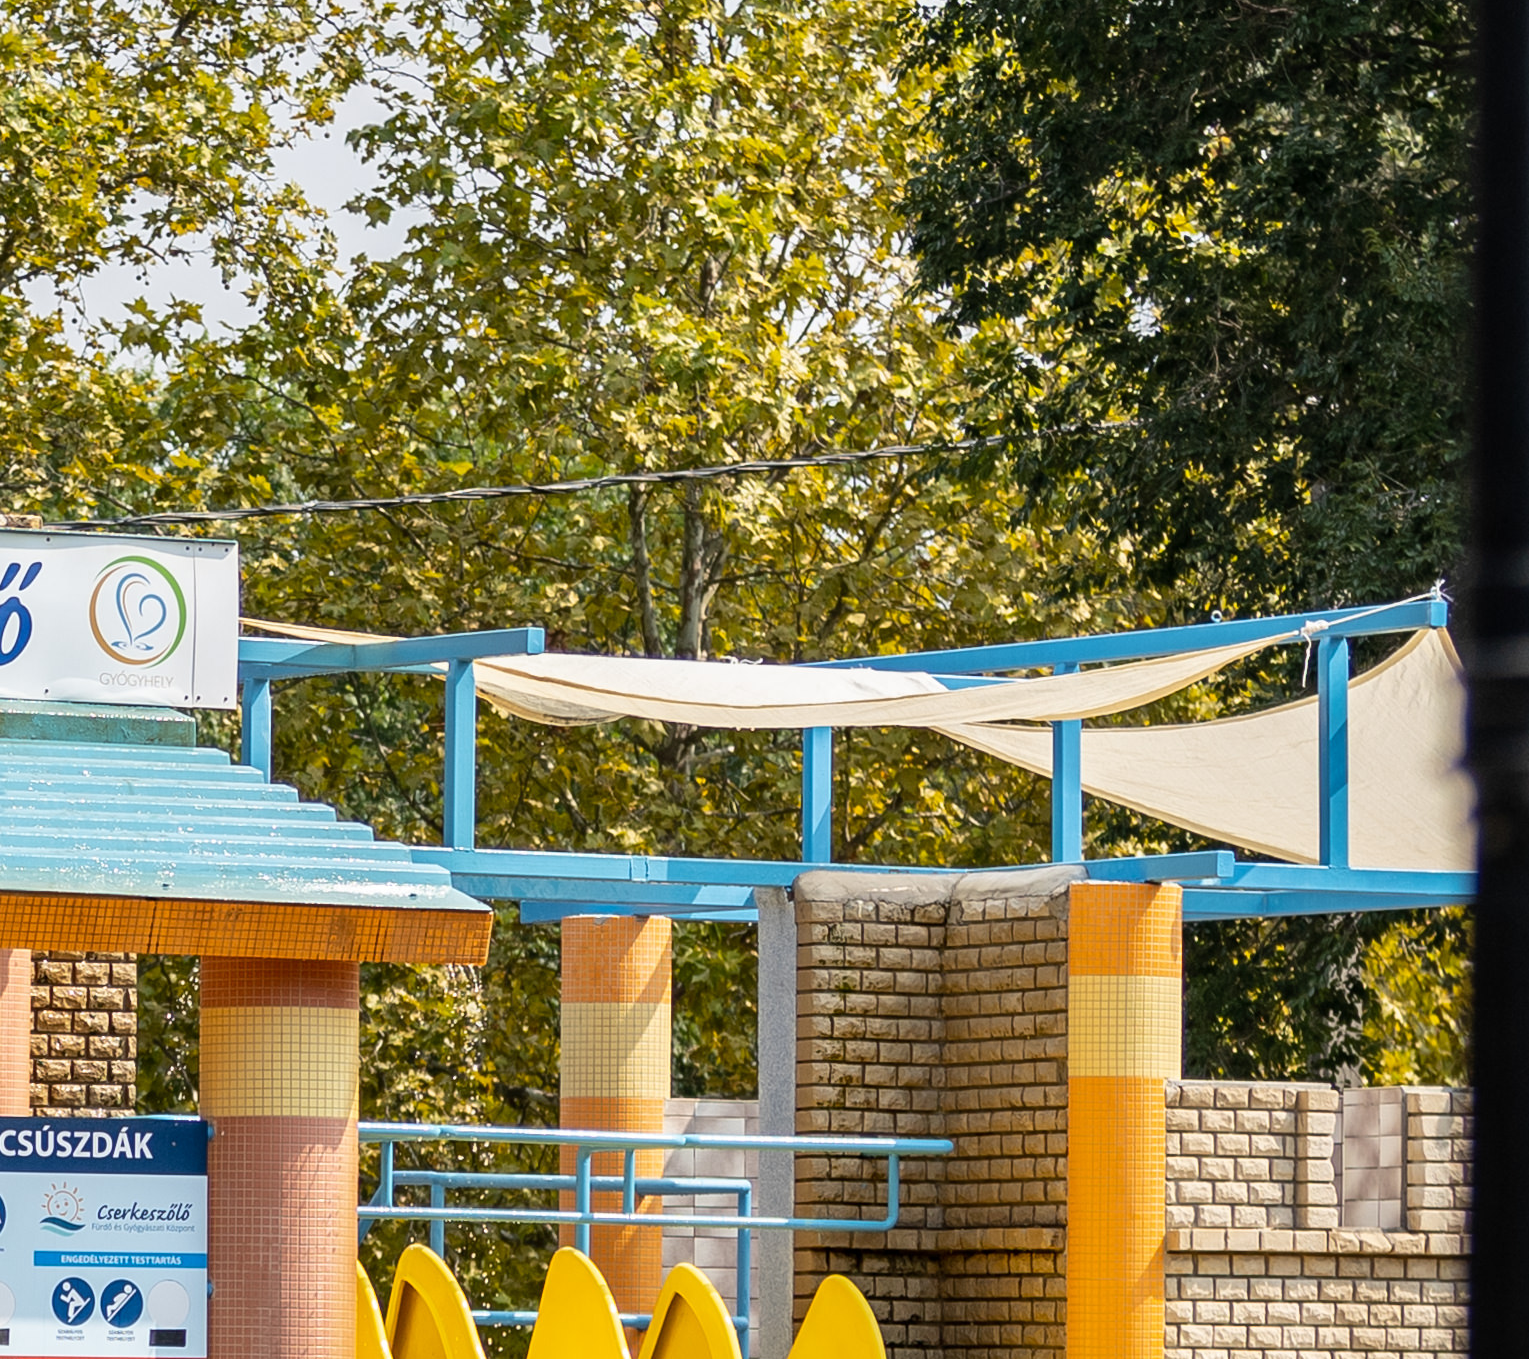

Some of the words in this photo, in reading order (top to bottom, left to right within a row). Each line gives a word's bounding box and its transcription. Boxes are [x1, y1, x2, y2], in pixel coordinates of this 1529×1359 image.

[99, 670, 174, 688] GYÓGYHELY
[97, 1202, 193, 1221] Cserkeszőlő
[60, 1253, 129, 1265] ENGEDÉLYEZETT
[131, 1254, 182, 1266] TESTTARTÁS
